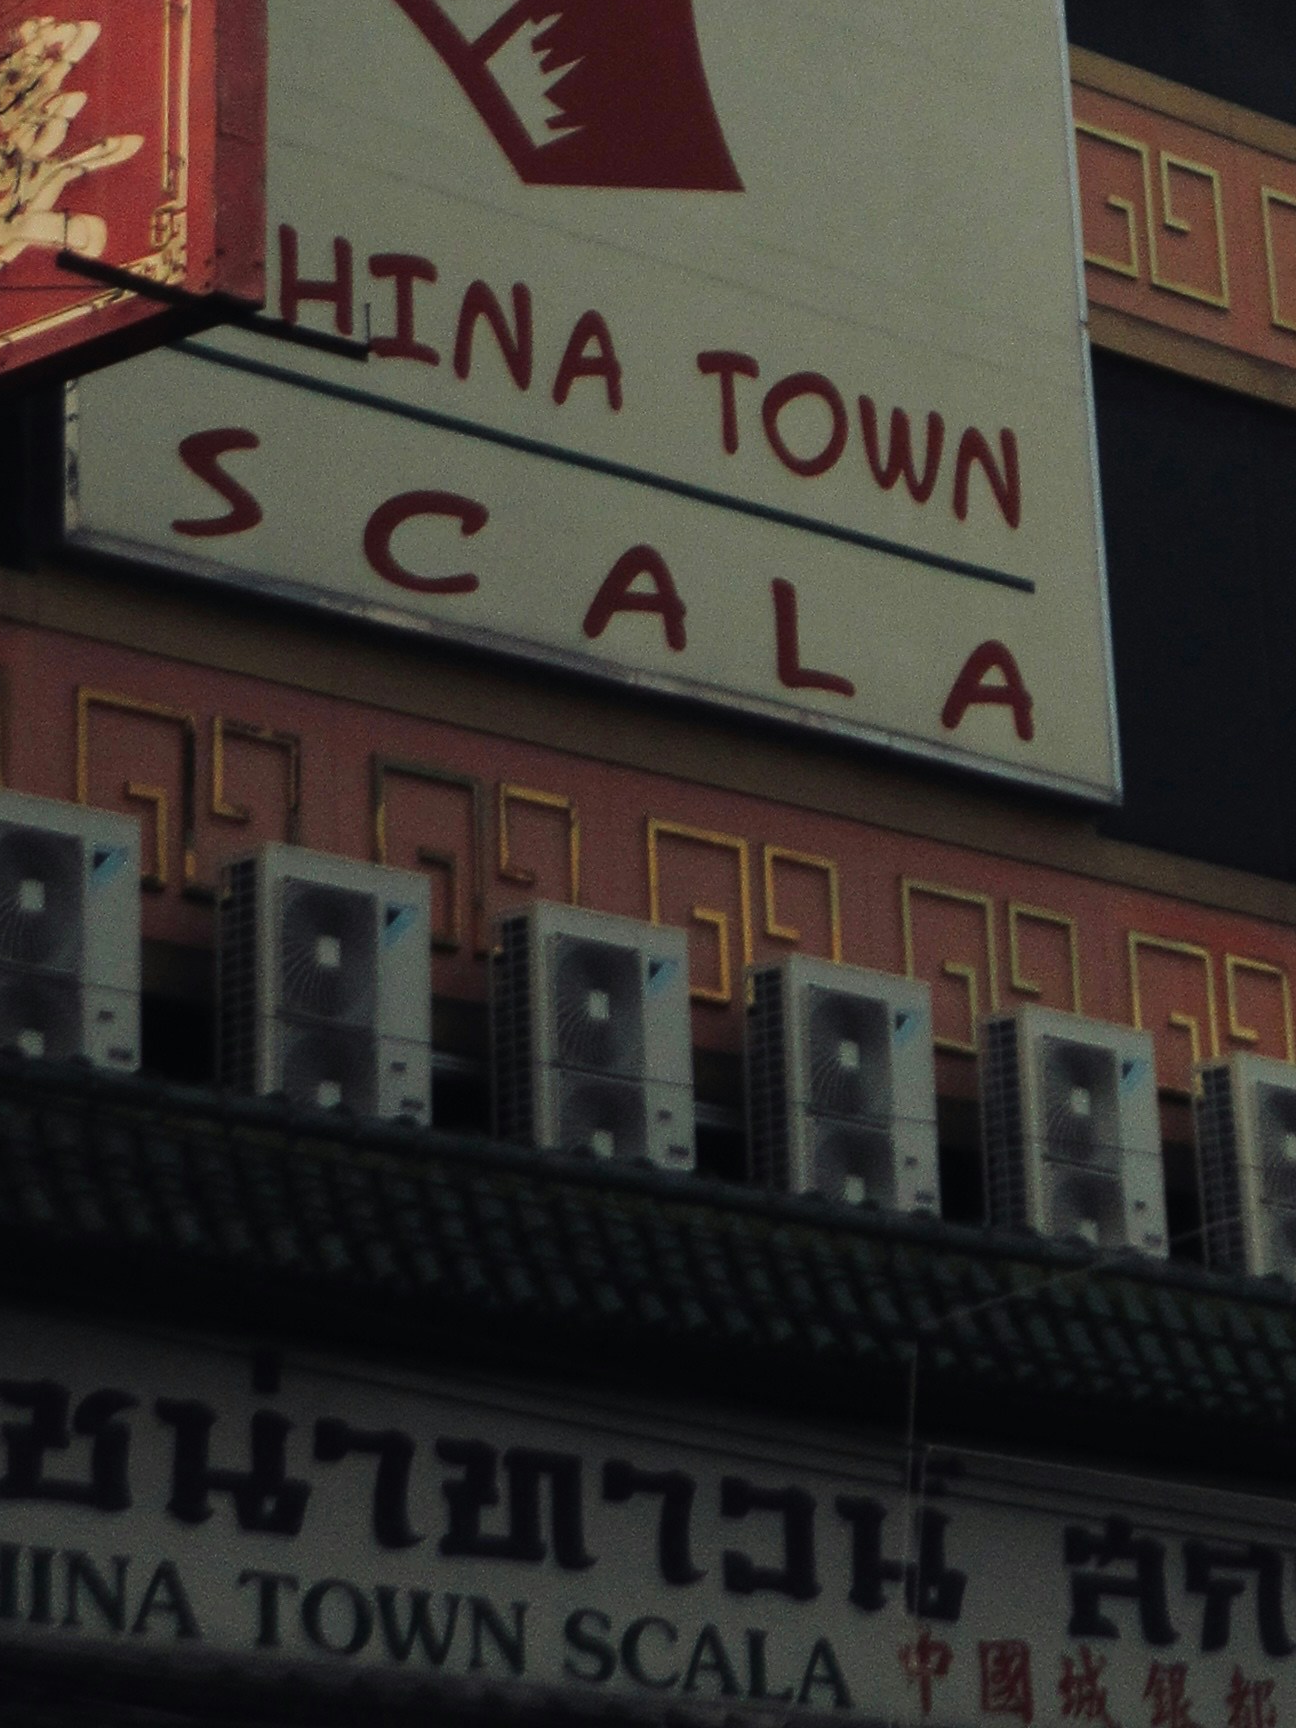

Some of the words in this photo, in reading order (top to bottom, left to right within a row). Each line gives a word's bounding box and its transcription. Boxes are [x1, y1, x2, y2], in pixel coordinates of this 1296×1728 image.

[279, 225, 622, 410] HINA
[696, 349, 1021, 529] TOWN
[171, 427, 1034, 742] SCALA
[237, 1568, 528, 1676] TOWN
[563, 1608, 853, 1710] SCALA
